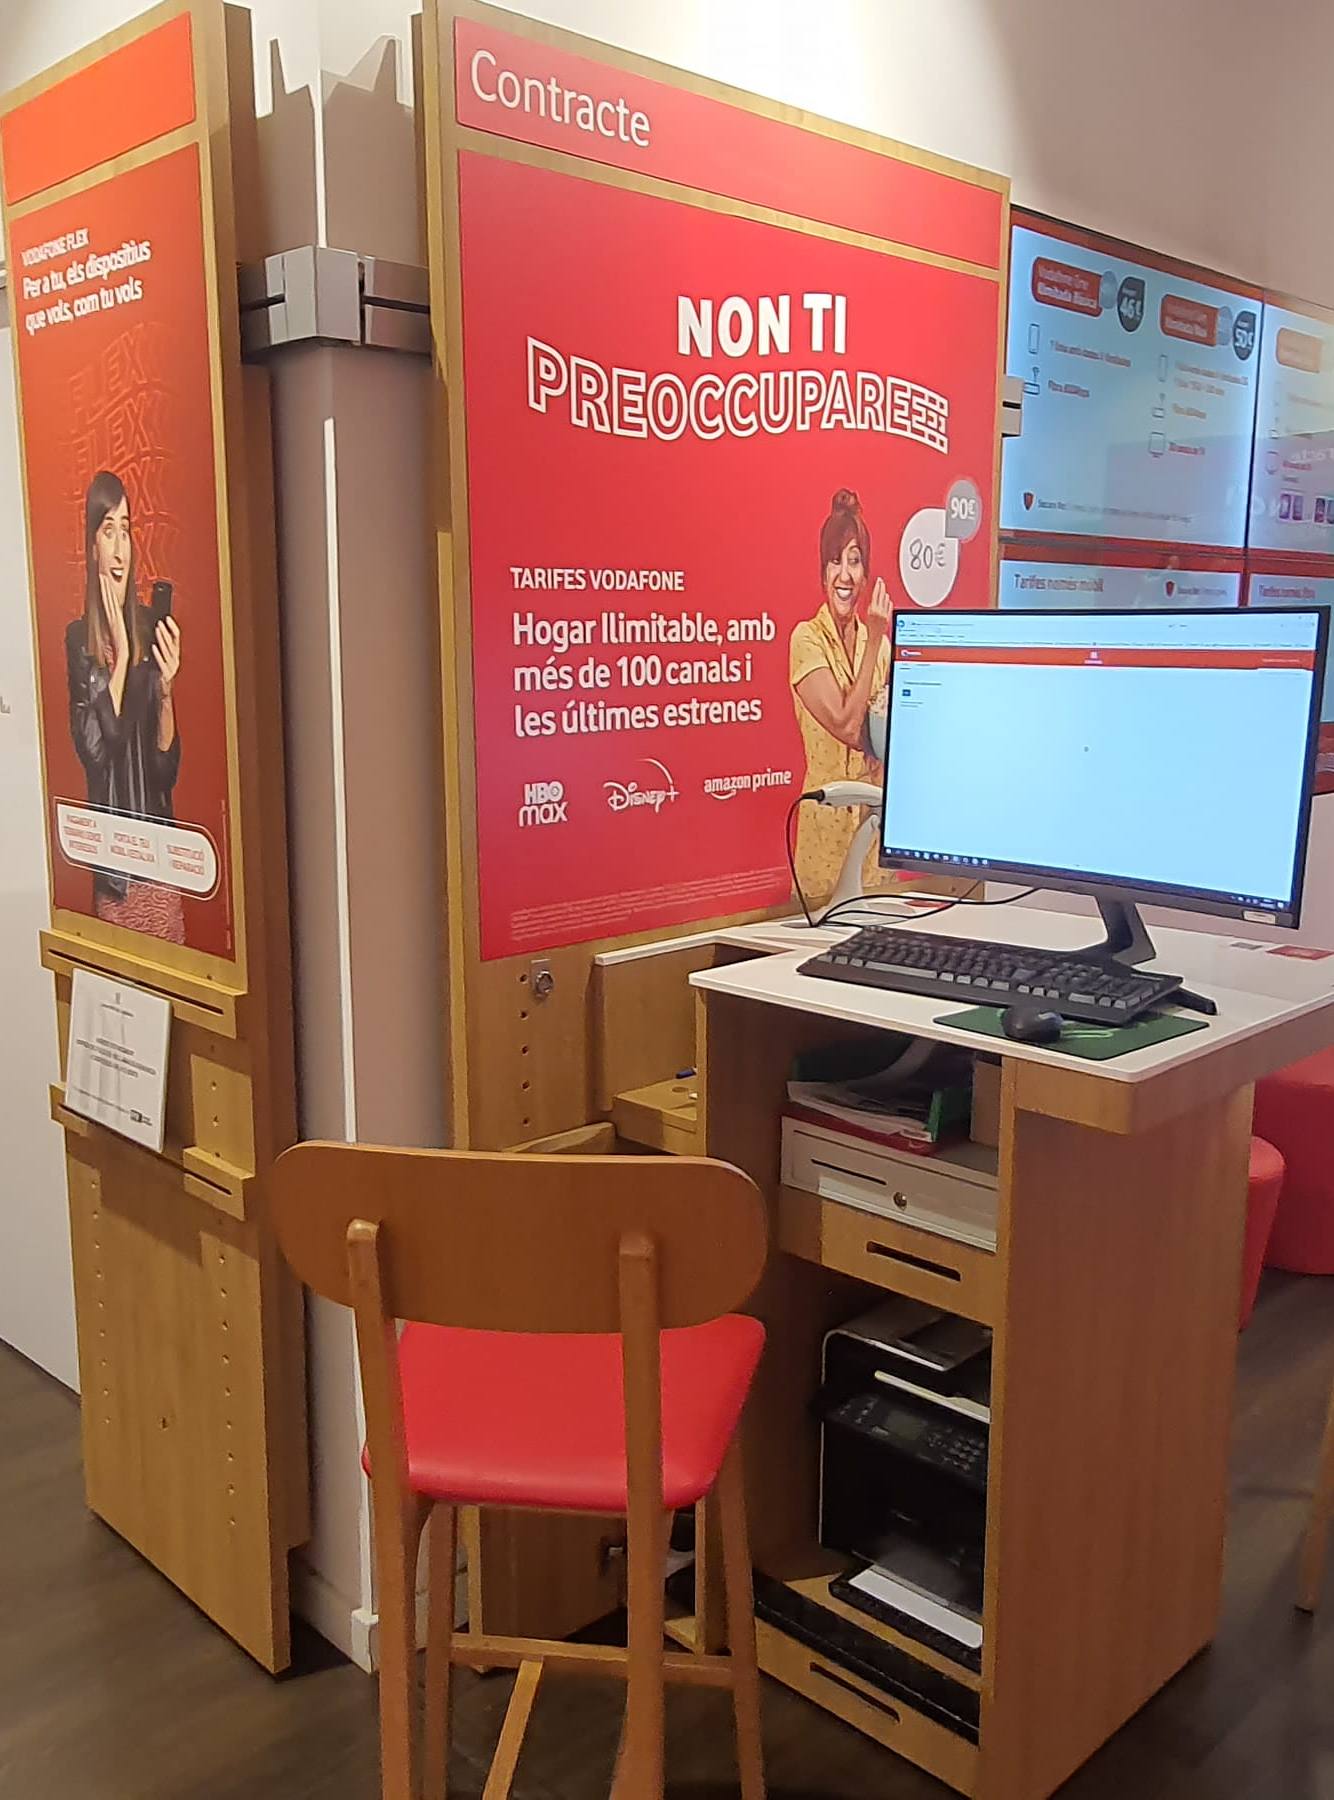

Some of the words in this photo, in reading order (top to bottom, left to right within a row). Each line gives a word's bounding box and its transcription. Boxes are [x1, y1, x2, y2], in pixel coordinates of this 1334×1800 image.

[471, 50, 651, 147] Contracte
[23, 277, 41, 299] Per
[42, 276, 50, 294] a
[67, 261, 85, 285] els
[85, 240, 152, 280] dispositius
[26, 310, 46, 336] que
[74, 293, 100, 316] com
[100, 287, 115, 309] tu
[115, 276, 143, 304] vols
[677, 295, 790, 358] NON
[802, 293, 847, 355] TI
[950, 496, 976, 520] 90€
[909, 538, 947, 571] 80€
[510, 567, 587, 590] TARIFES
[589, 569, 685, 591] VODAFONE
[513, 612, 597, 653] Hogar
[726, 612, 776, 642] amb
[514, 656, 574, 691] més
[578, 657, 612, 689] de
[616, 655, 662, 687] 100
[665, 653, 741, 685] canals
[745, 652, 752, 682] i
[515, 704, 556, 738] les
[562, 700, 660, 734] últimes
[663, 698, 762, 727] estrenes
[524, 781, 564, 806] HBO
[704, 774, 751, 799] amazon
[752, 768, 792, 792] prime
[519, 802, 568, 827] max
